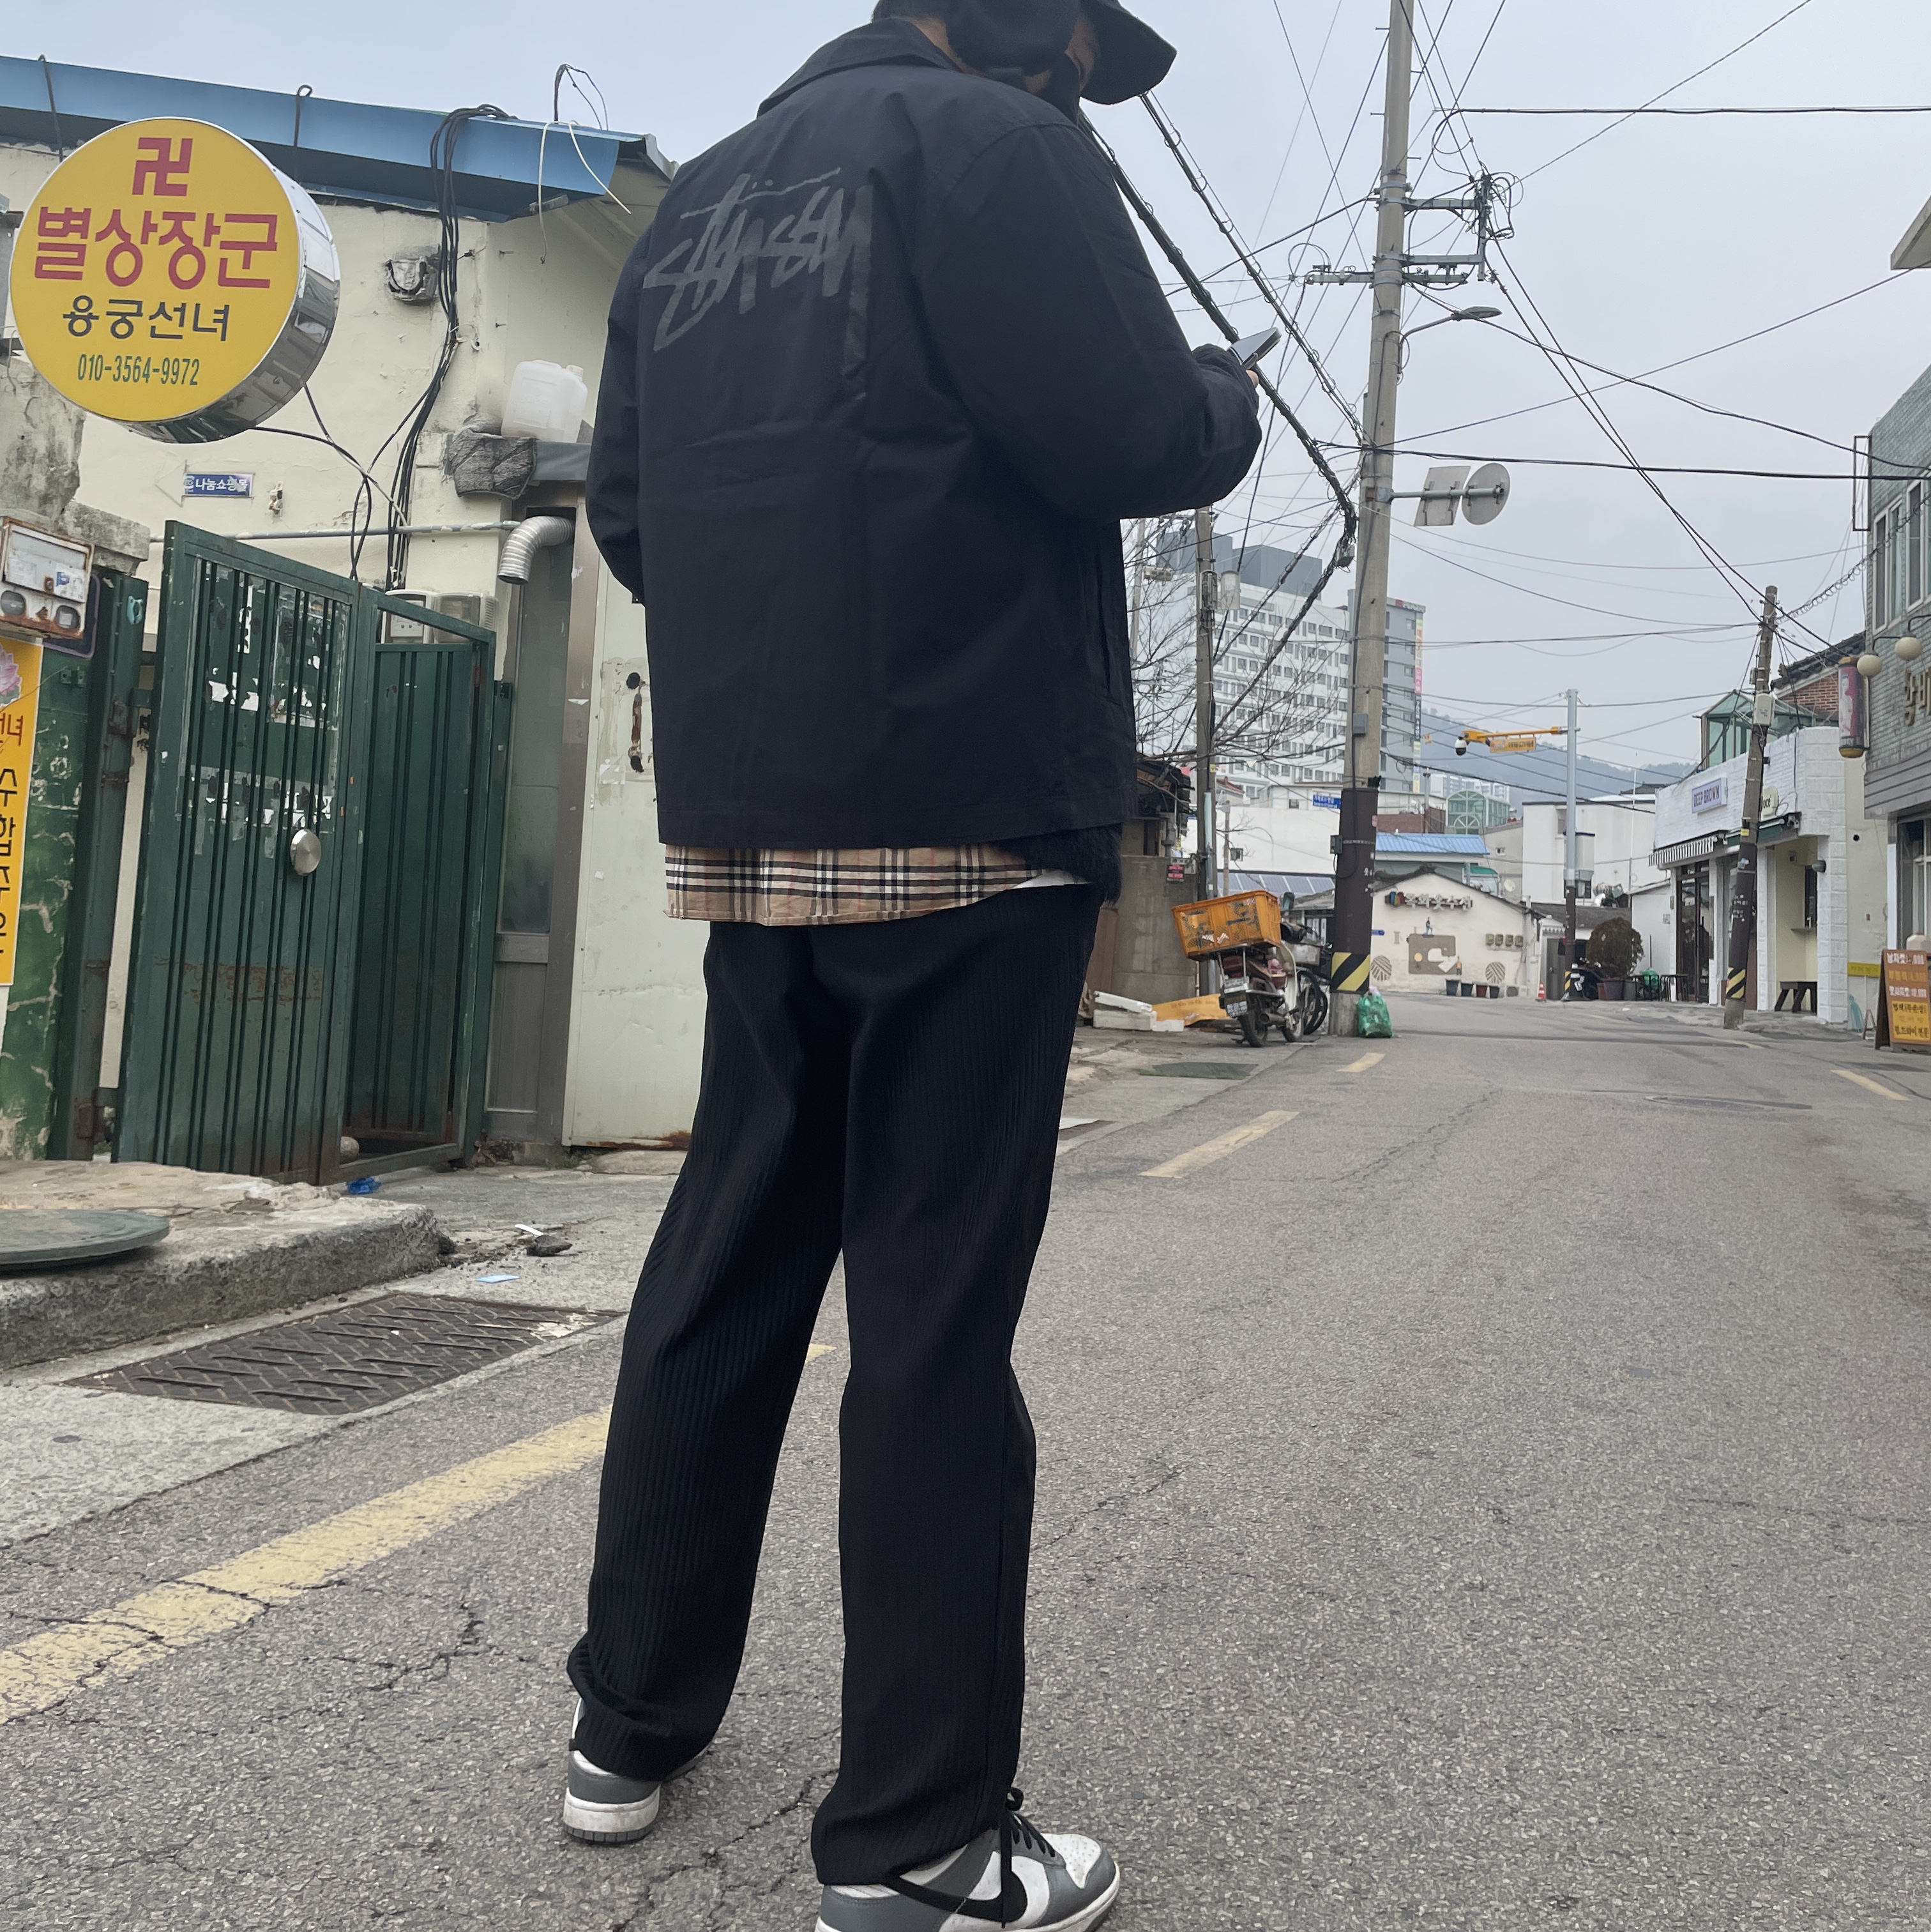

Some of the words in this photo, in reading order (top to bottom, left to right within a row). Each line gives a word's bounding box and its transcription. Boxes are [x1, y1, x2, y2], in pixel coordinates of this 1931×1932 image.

[34, 206, 278, 290] 별상장군
[63, 295, 230, 342] 용궁선녀
[78, 353, 201, 386] 010-3564-9972
[1693, 791, 1703, 807] DEEP
